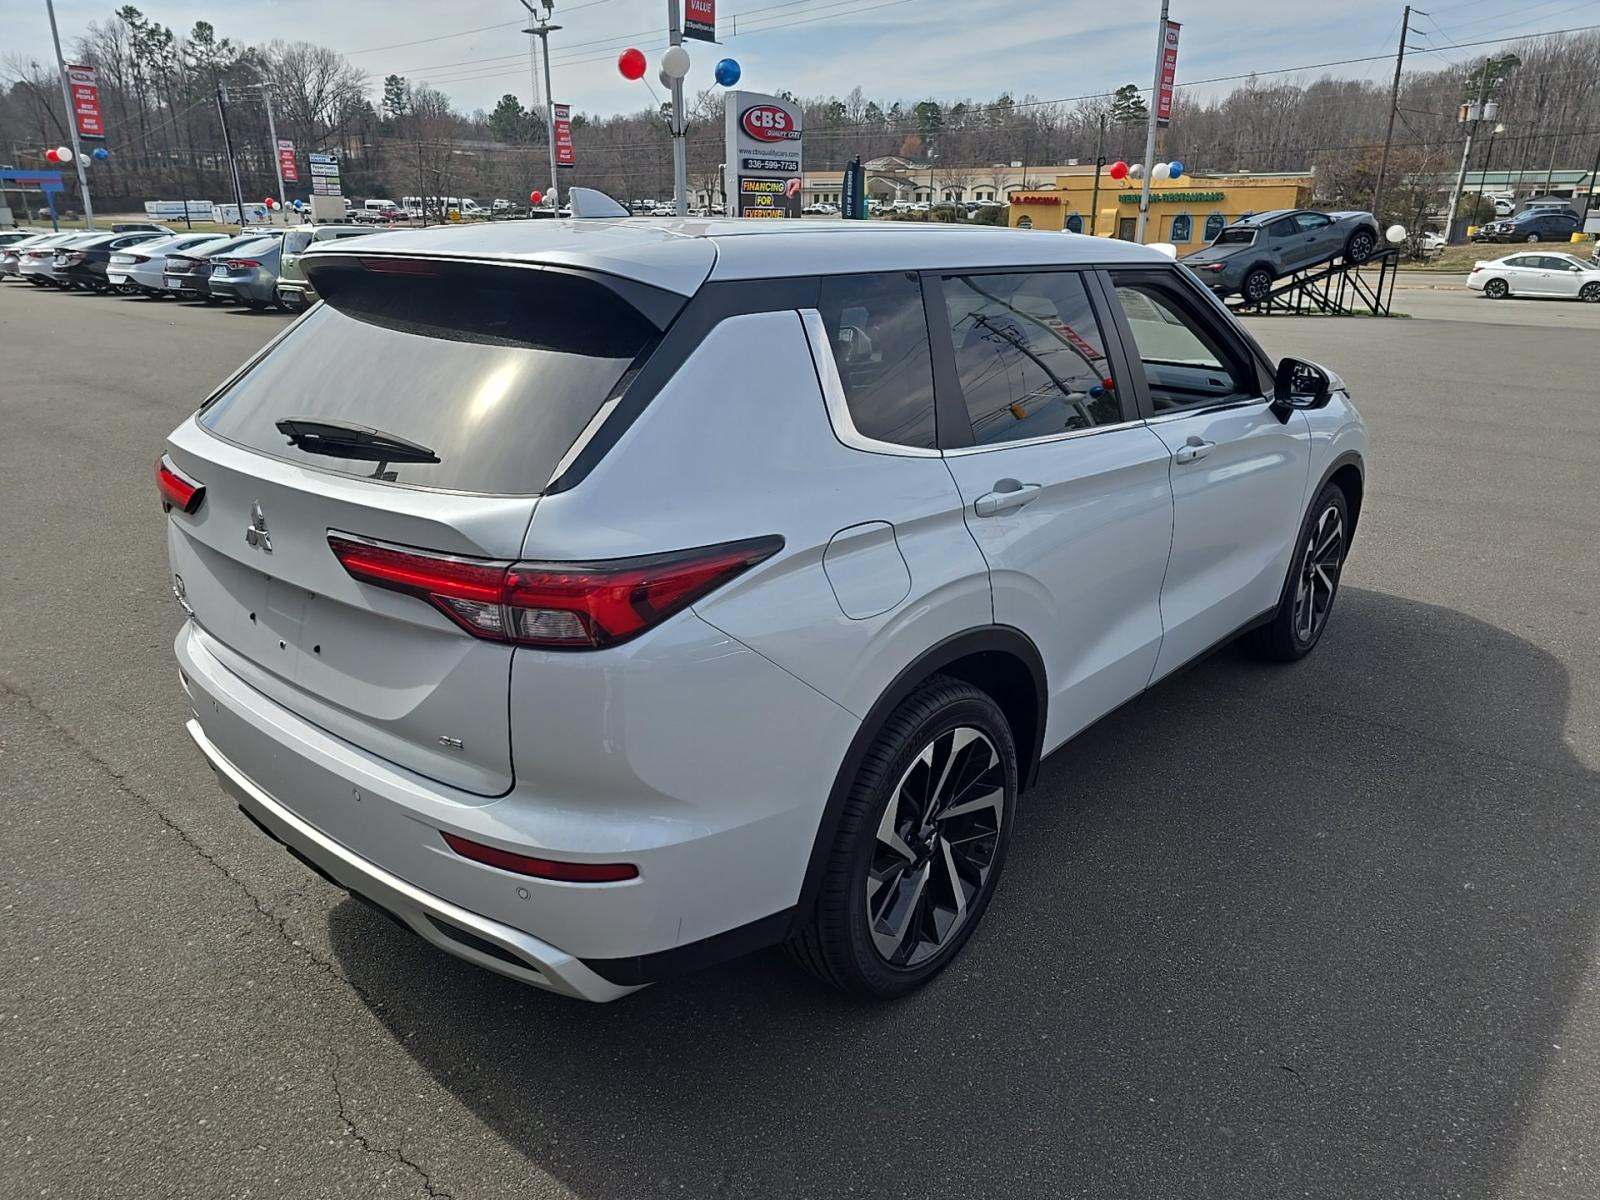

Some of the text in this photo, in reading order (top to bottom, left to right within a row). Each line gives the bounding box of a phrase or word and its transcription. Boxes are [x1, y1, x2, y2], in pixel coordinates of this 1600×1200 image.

[691, 0, 711, 13] VALUE
[750, 110, 786, 128] CBS
[747, 160, 797, 170] 336-599-7735
[743, 181, 785, 192] FINANCING
[757, 195, 772, 205] FOR
